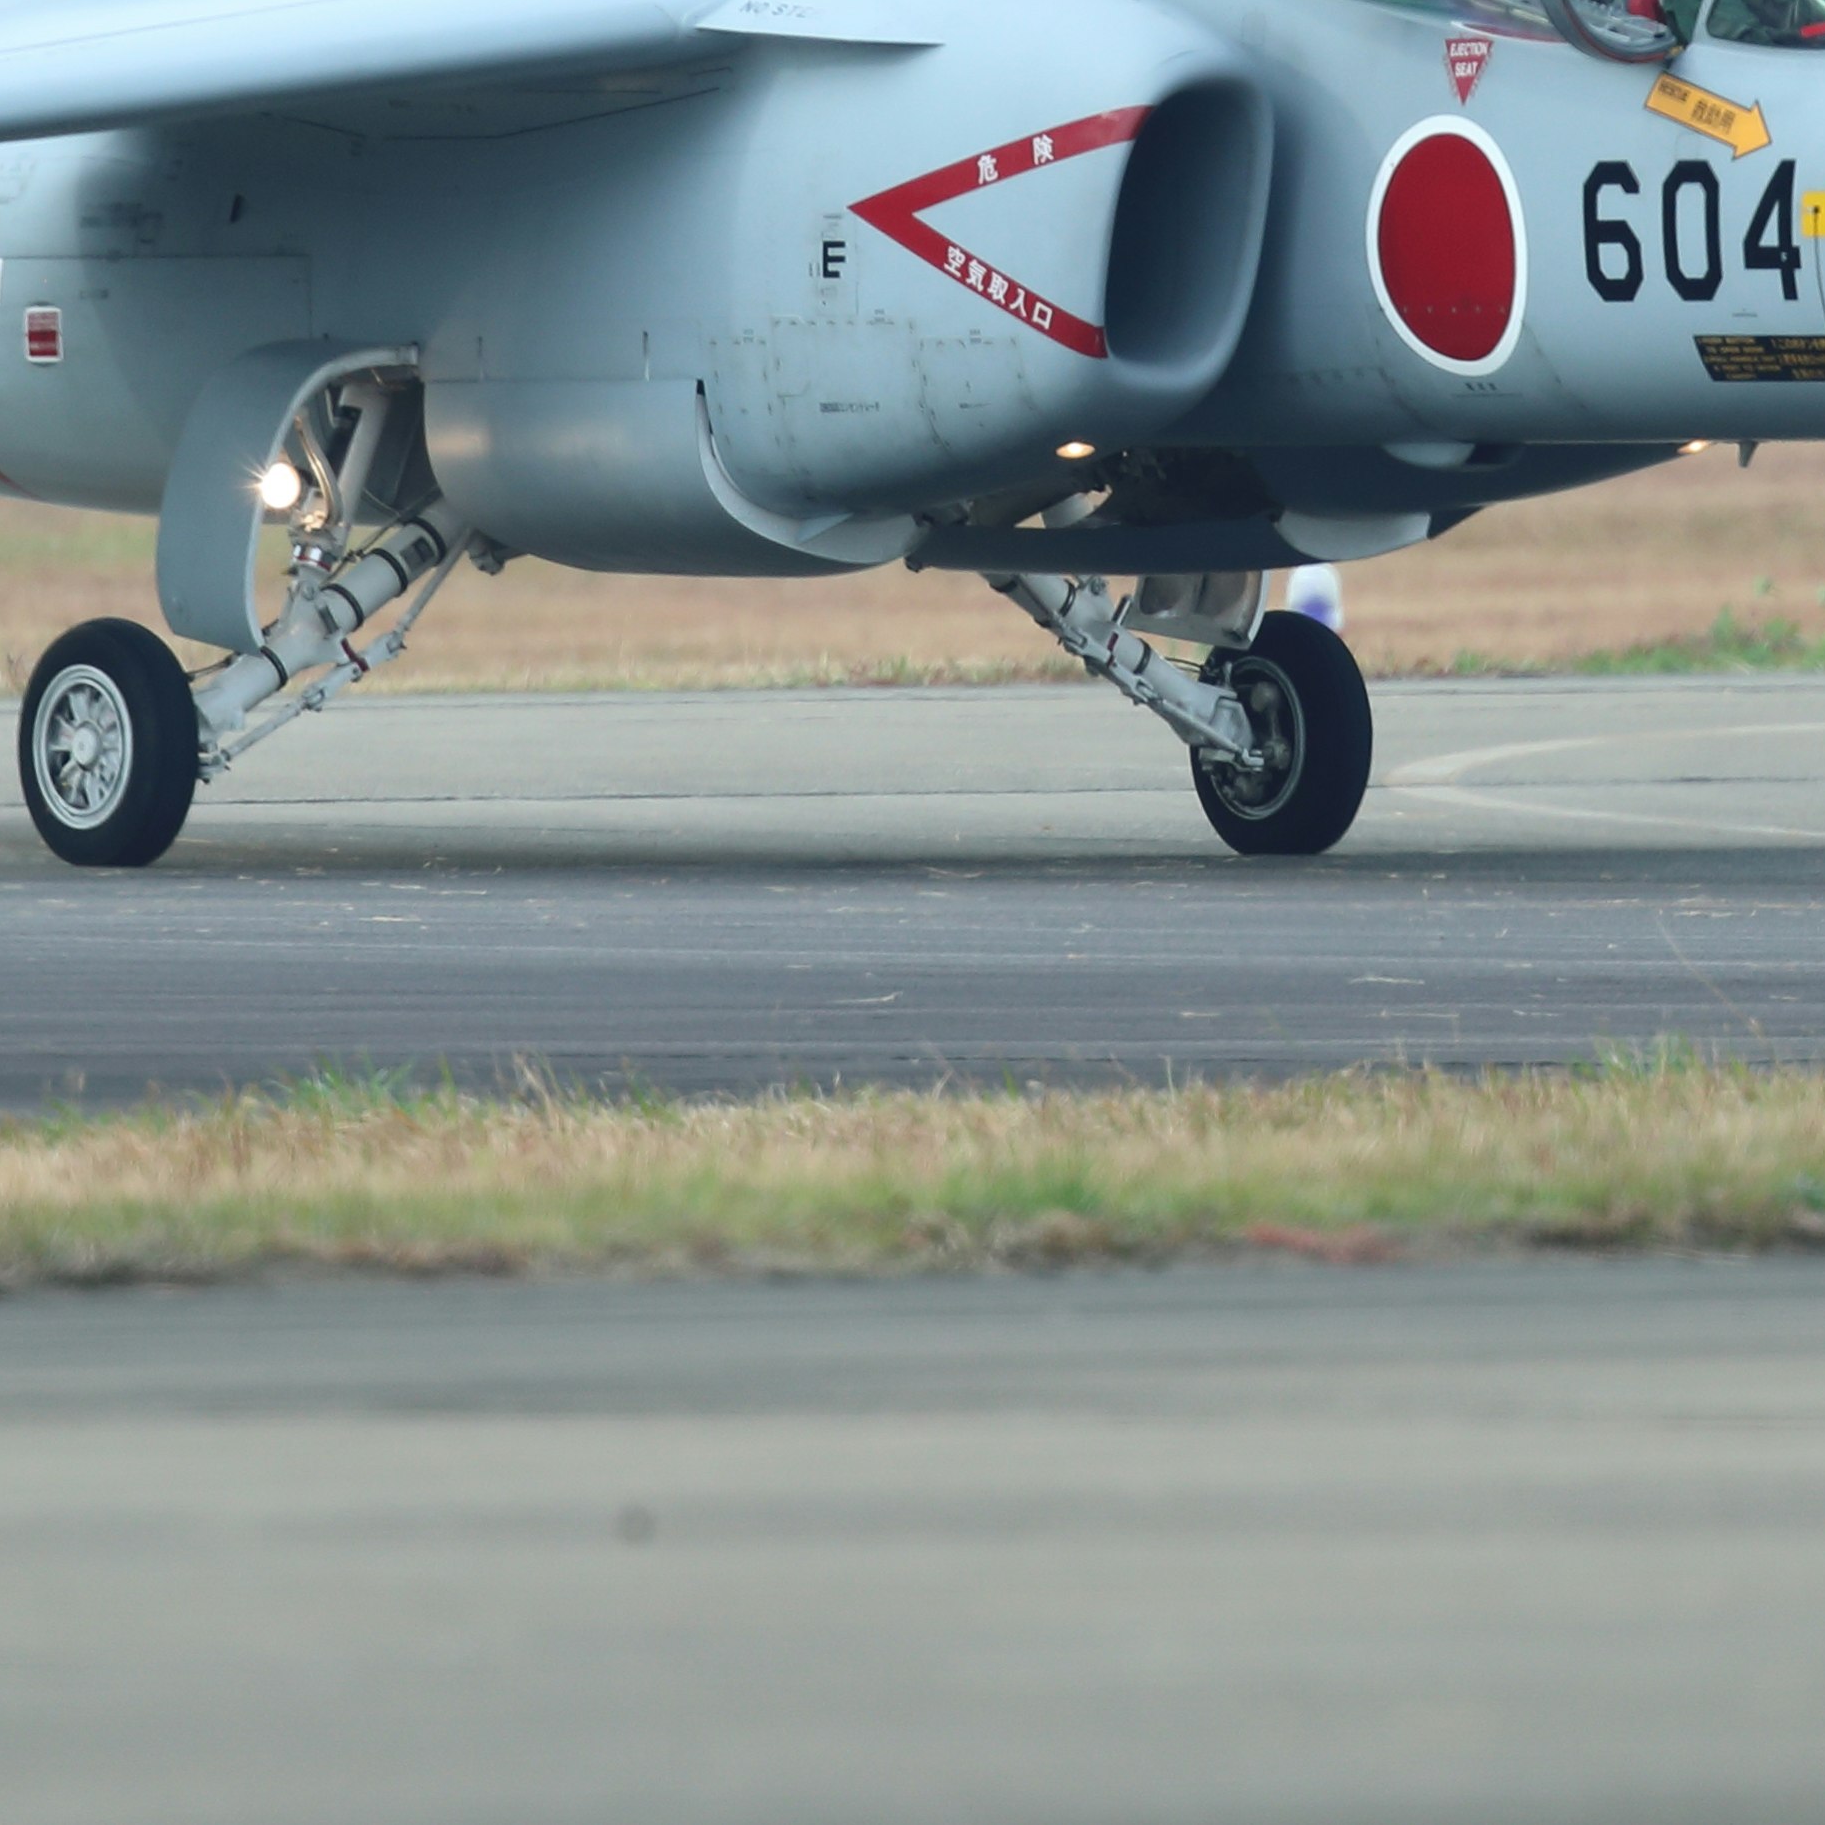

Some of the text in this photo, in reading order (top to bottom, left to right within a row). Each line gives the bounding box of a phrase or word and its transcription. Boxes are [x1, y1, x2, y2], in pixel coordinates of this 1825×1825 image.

[1450, 41, 1490, 57] EJECTION
[1455, 61, 1479, 77] SEAT
[977, 133, 1055, 185] 危険
[1583, 159, 1802, 302] 604
[822, 240, 846, 279] E
[943, 244, 1054, 331] 空気取入口
